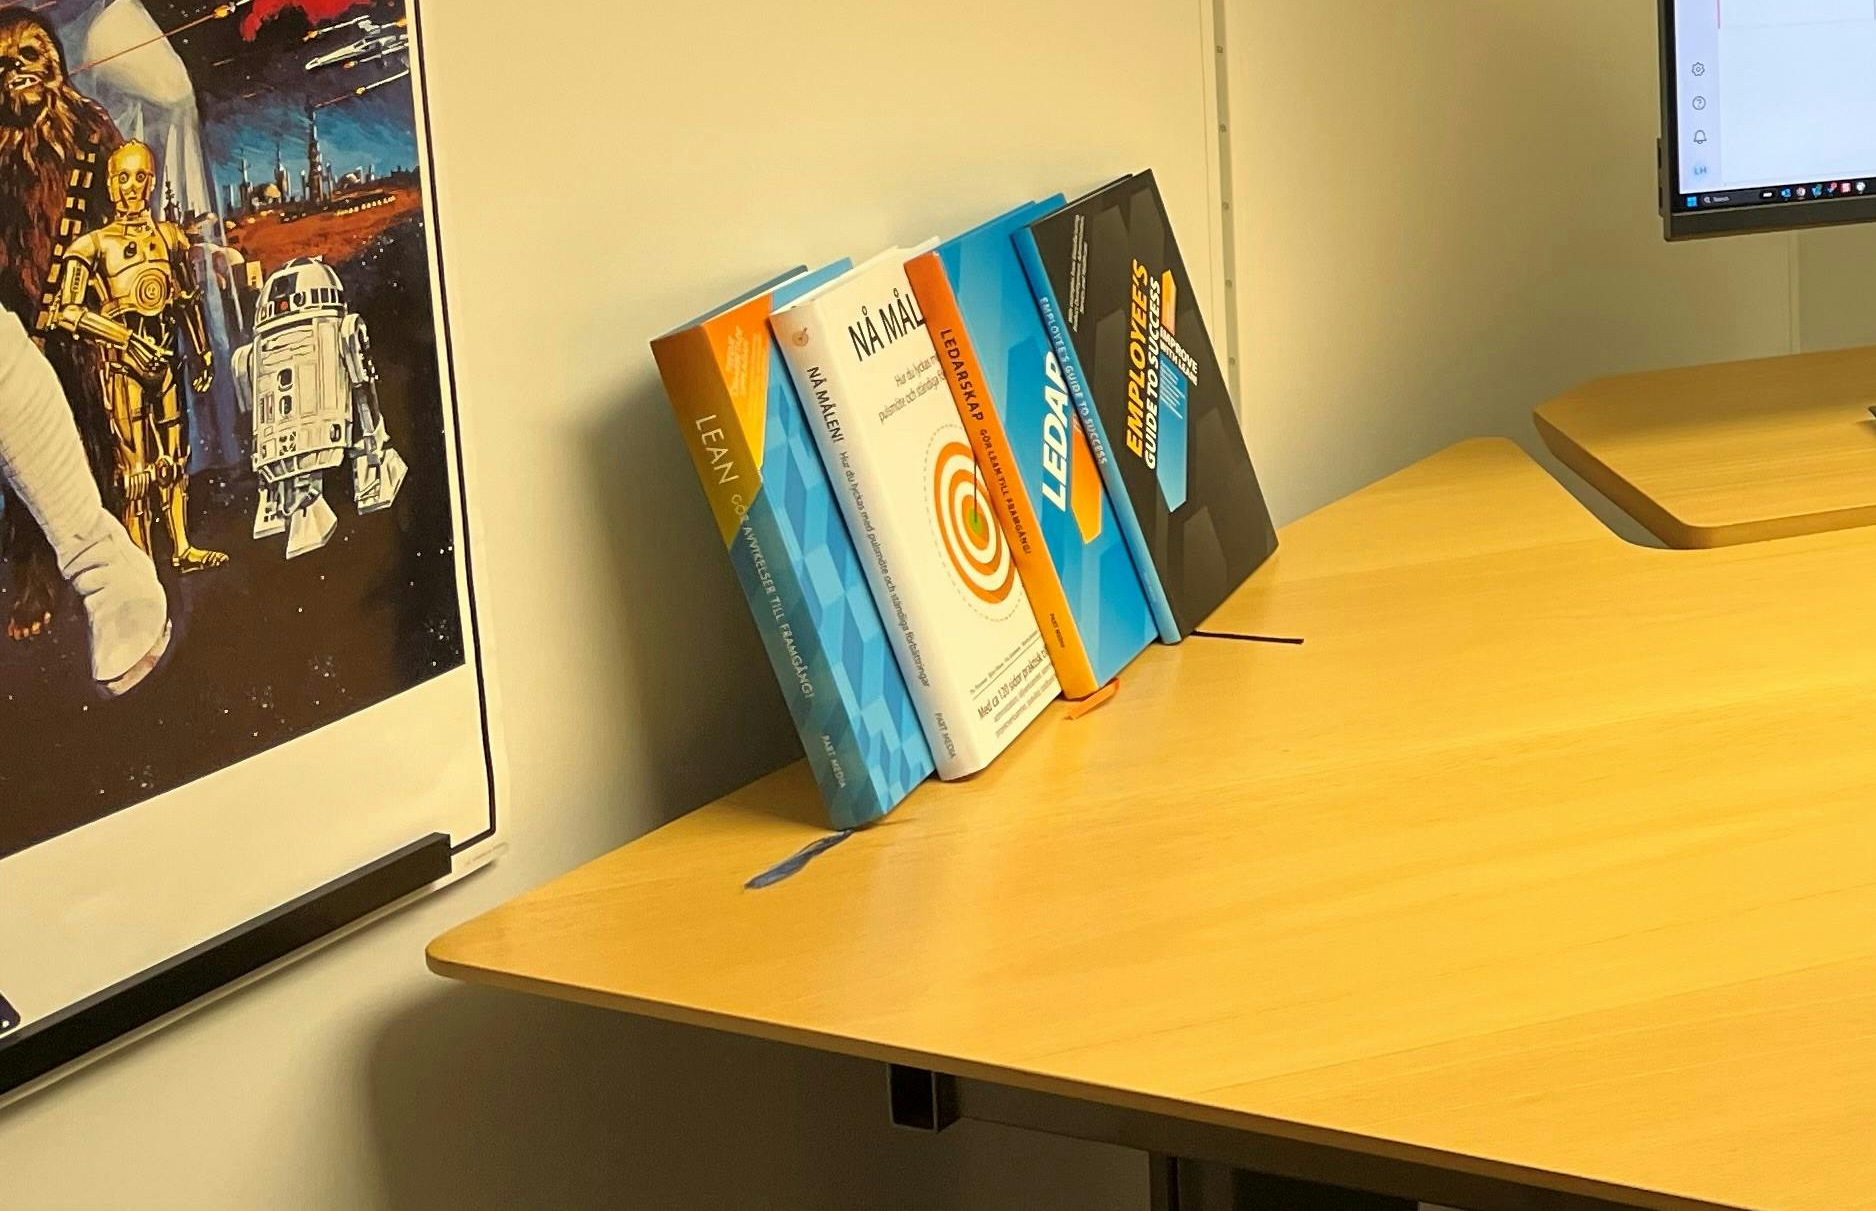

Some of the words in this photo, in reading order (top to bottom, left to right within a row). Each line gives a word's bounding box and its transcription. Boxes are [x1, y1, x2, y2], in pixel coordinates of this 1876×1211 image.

[848, 305, 885, 363] NÅ
[1125, 257, 1149, 459] EMPLOYEE'S
[1147, 276, 1162, 368] SUCCESS
[1159, 324, 1199, 375] IMPROVE
[940, 328, 984, 422] LEDARSKAP
[1064, 364, 1084, 402] GUIDE
[1077, 401, 1090, 417] TO
[1084, 417, 1108, 465] SUCCESS
[1146, 368, 1161, 399] TO
[806, 365, 828, 390] NÅ
[840, 451, 851, 469] Hur
[861, 511, 875, 533] med
[884, 575, 897, 594] och
[1143, 399, 1160, 470] GUIDE
[695, 413, 741, 485] LEAN
[742, 525, 778, 595] AVVIKELSER
[769, 595, 786, 622] TILL
